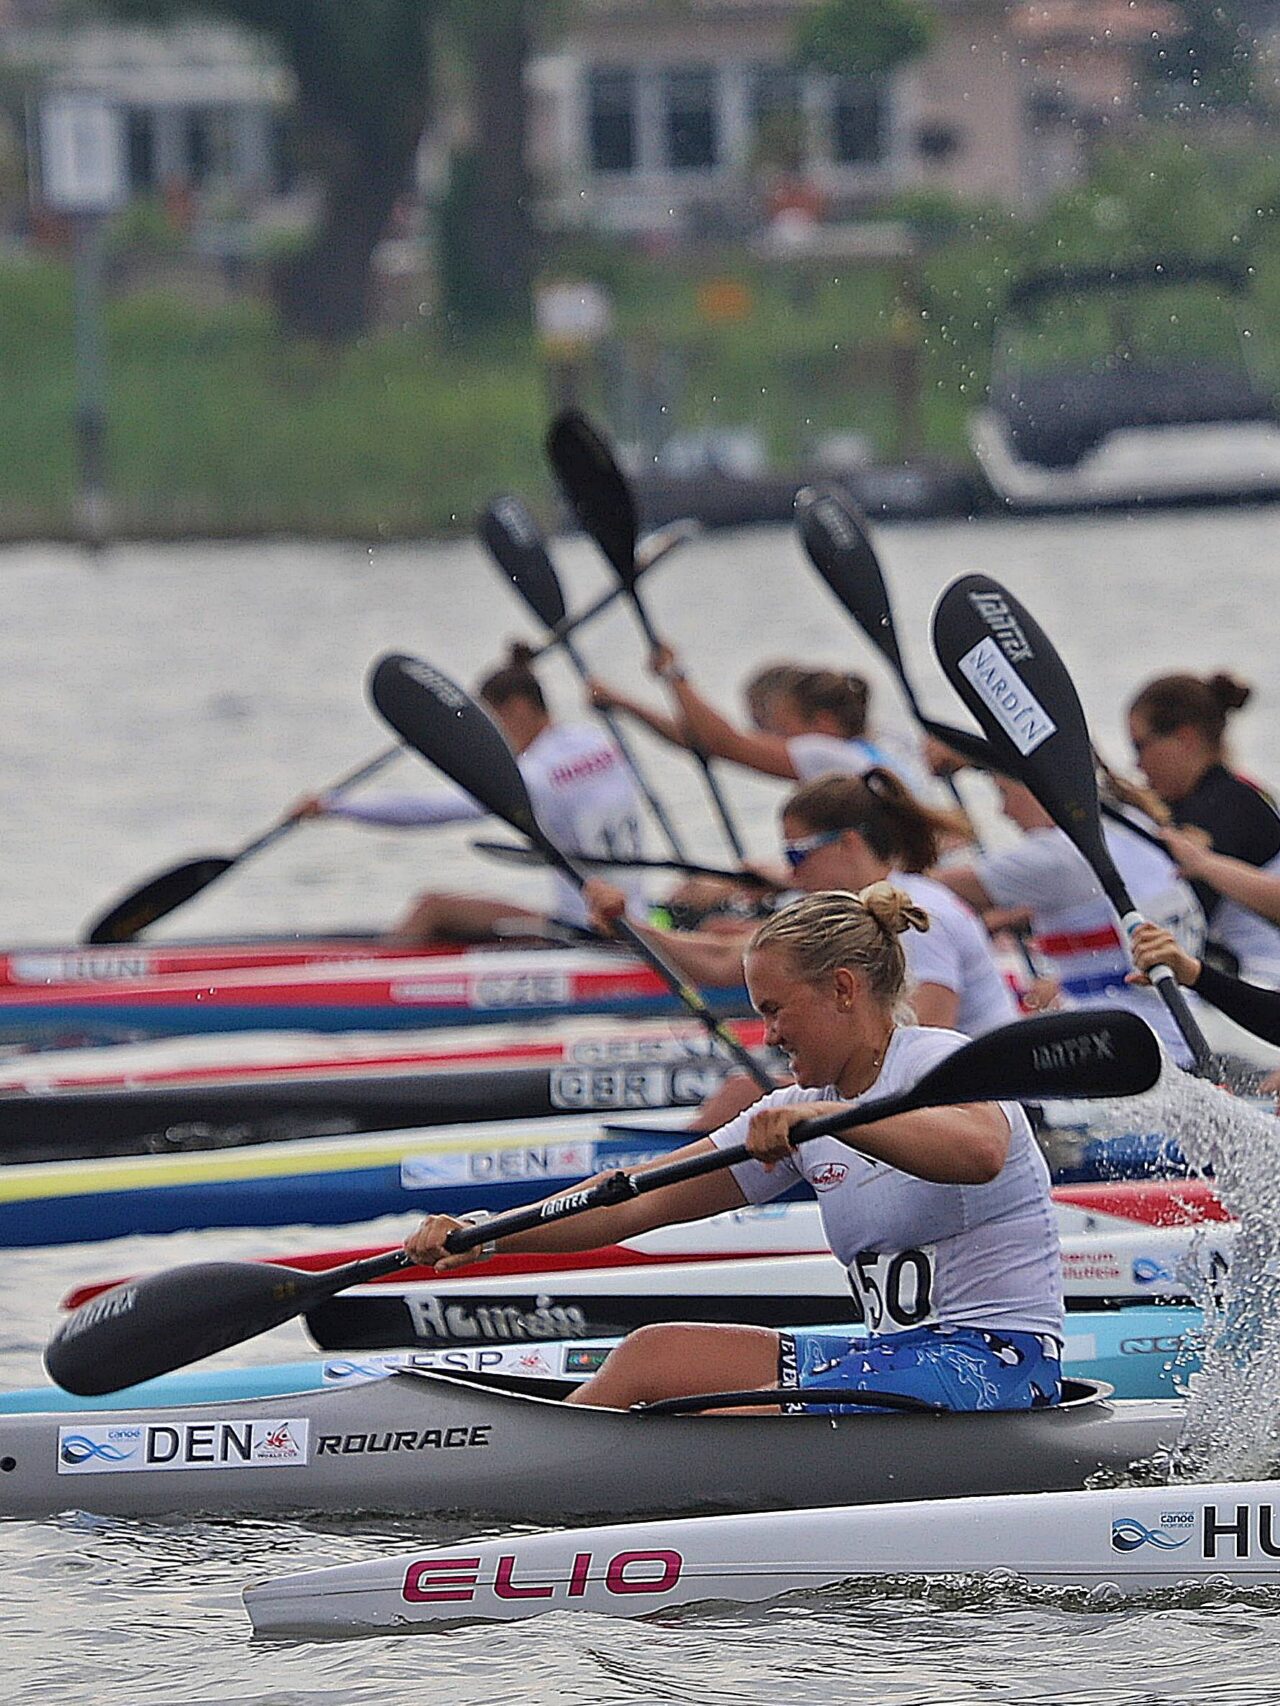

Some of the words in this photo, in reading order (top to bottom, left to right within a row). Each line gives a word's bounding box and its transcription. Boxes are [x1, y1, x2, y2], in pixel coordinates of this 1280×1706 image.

[855, 1249, 932, 1331] 50
[408, 1351, 503, 1371] ESP
[147, 1424, 253, 1463] DEN
[1160, 1514, 1195, 1523] canoe
[402, 1550, 683, 1602] ELIO
